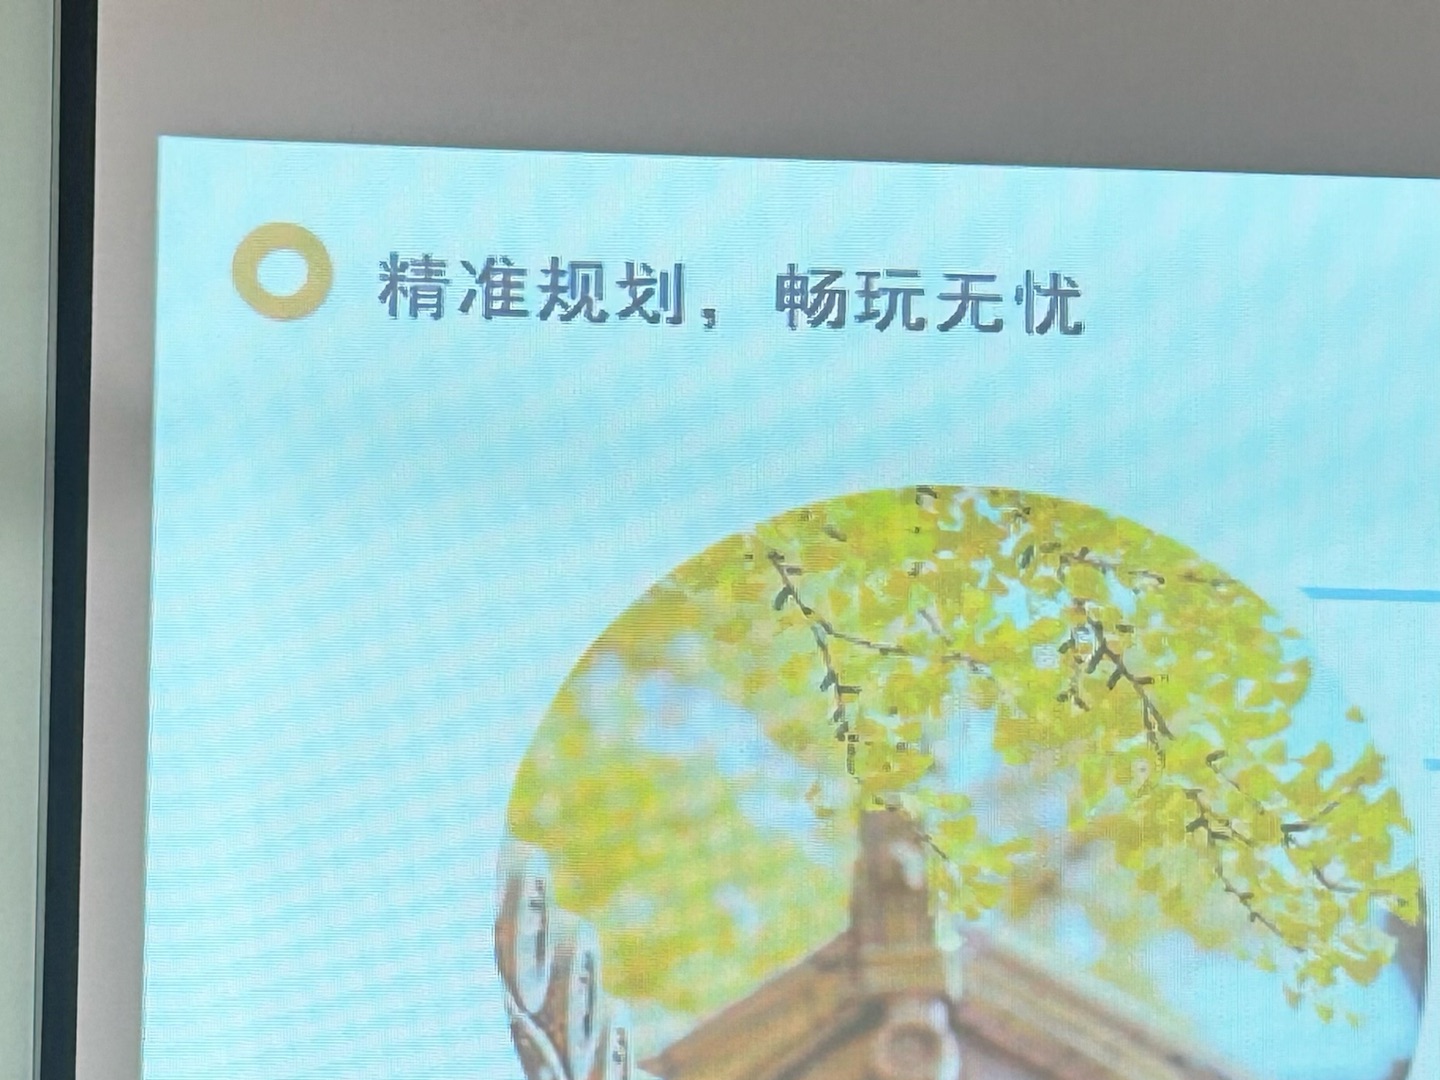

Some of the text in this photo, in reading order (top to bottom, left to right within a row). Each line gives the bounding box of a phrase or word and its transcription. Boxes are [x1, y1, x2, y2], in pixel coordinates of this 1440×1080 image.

[377, 252, 1085, 337] 精准规划，畅玩无忧
